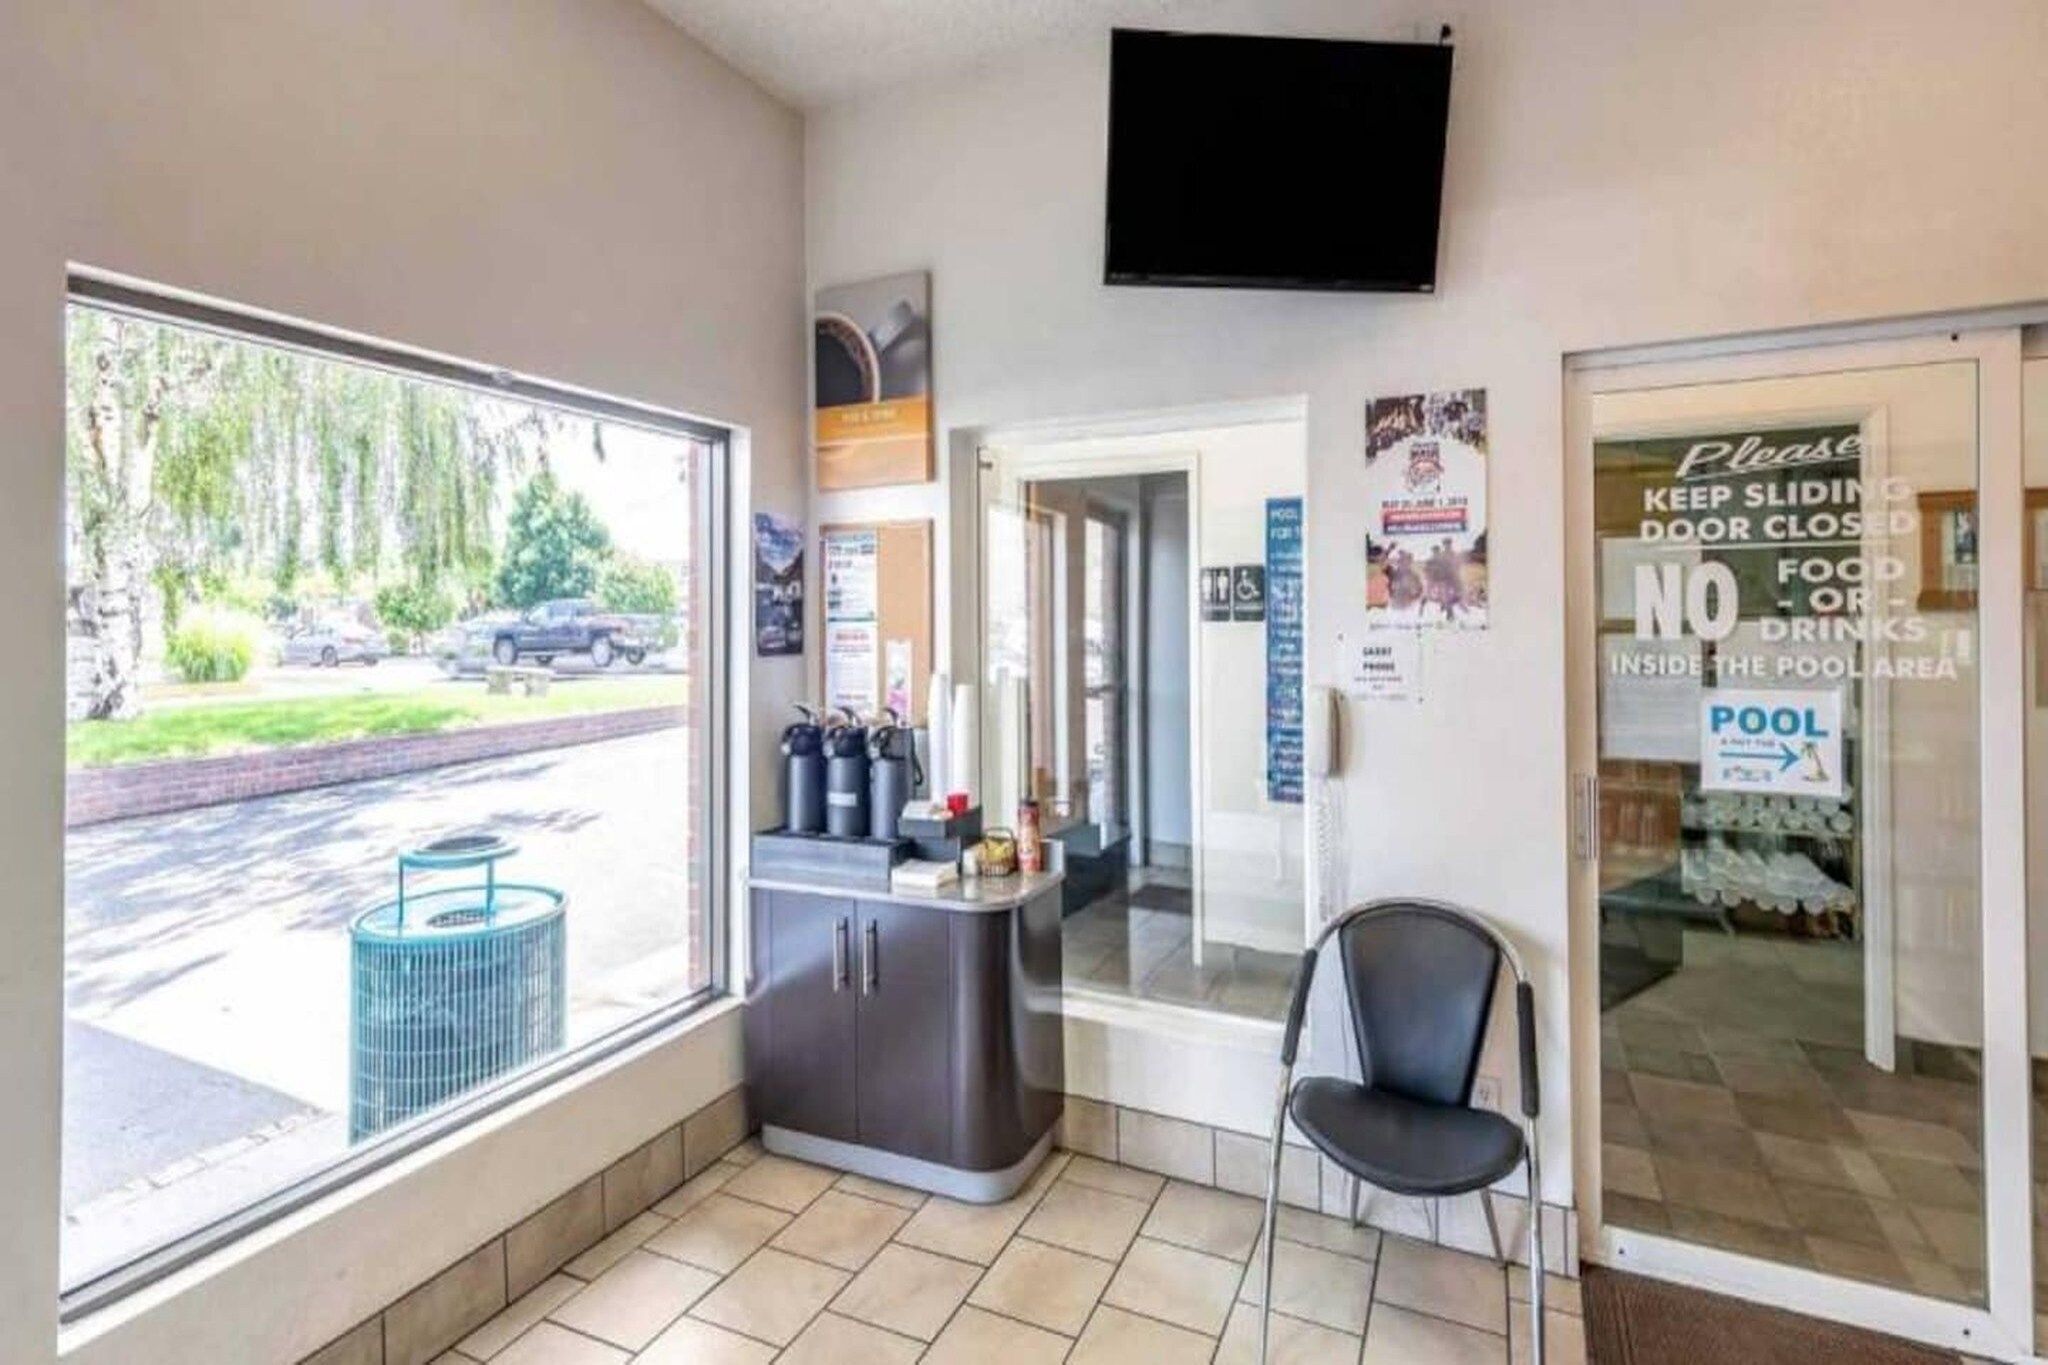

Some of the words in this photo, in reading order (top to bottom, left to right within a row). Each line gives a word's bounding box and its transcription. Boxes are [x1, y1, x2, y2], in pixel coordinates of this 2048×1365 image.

[1675, 434, 1865, 478] Please
[1643, 484, 1732, 513] KEEP
[1744, 475, 1913, 509] SLIDING
[1640, 515, 1751, 543] DOOR
[1762, 510, 1917, 539] CLOSED
[1777, 557, 1905, 584] FOOD
[1634, 561, 1740, 641] NO
[1809, 586, 1872, 613] OR
[1760, 615, 1928, 642] DRINKS
[1611, 654, 1705, 676] INSIDE
[1714, 654, 1765, 676] THE
[1777, 655, 1864, 678] POOL
[1871, 657, 1958, 680] AREA
[1711, 705, 1829, 738] POOL
